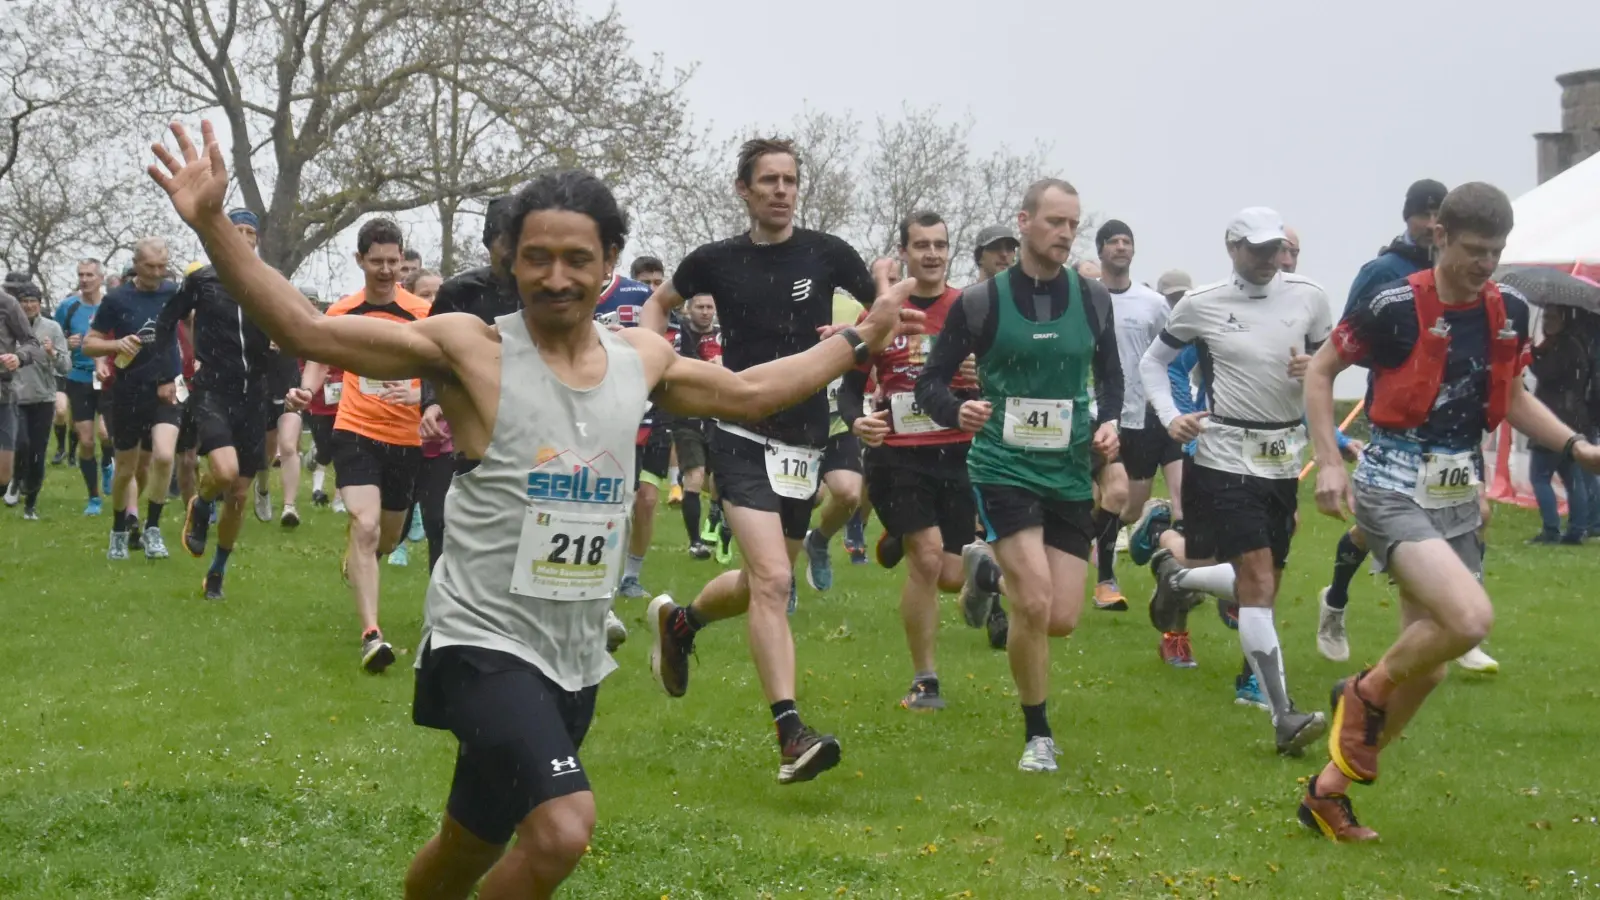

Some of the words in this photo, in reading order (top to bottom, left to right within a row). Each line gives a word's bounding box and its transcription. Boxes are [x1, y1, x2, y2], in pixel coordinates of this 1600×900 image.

[1027, 410, 1049, 429] 41
[1259, 440, 1287, 457] 189
[781, 457, 808, 479] 170
[1439, 466, 1469, 487] 106
[547, 533, 606, 566] 218
